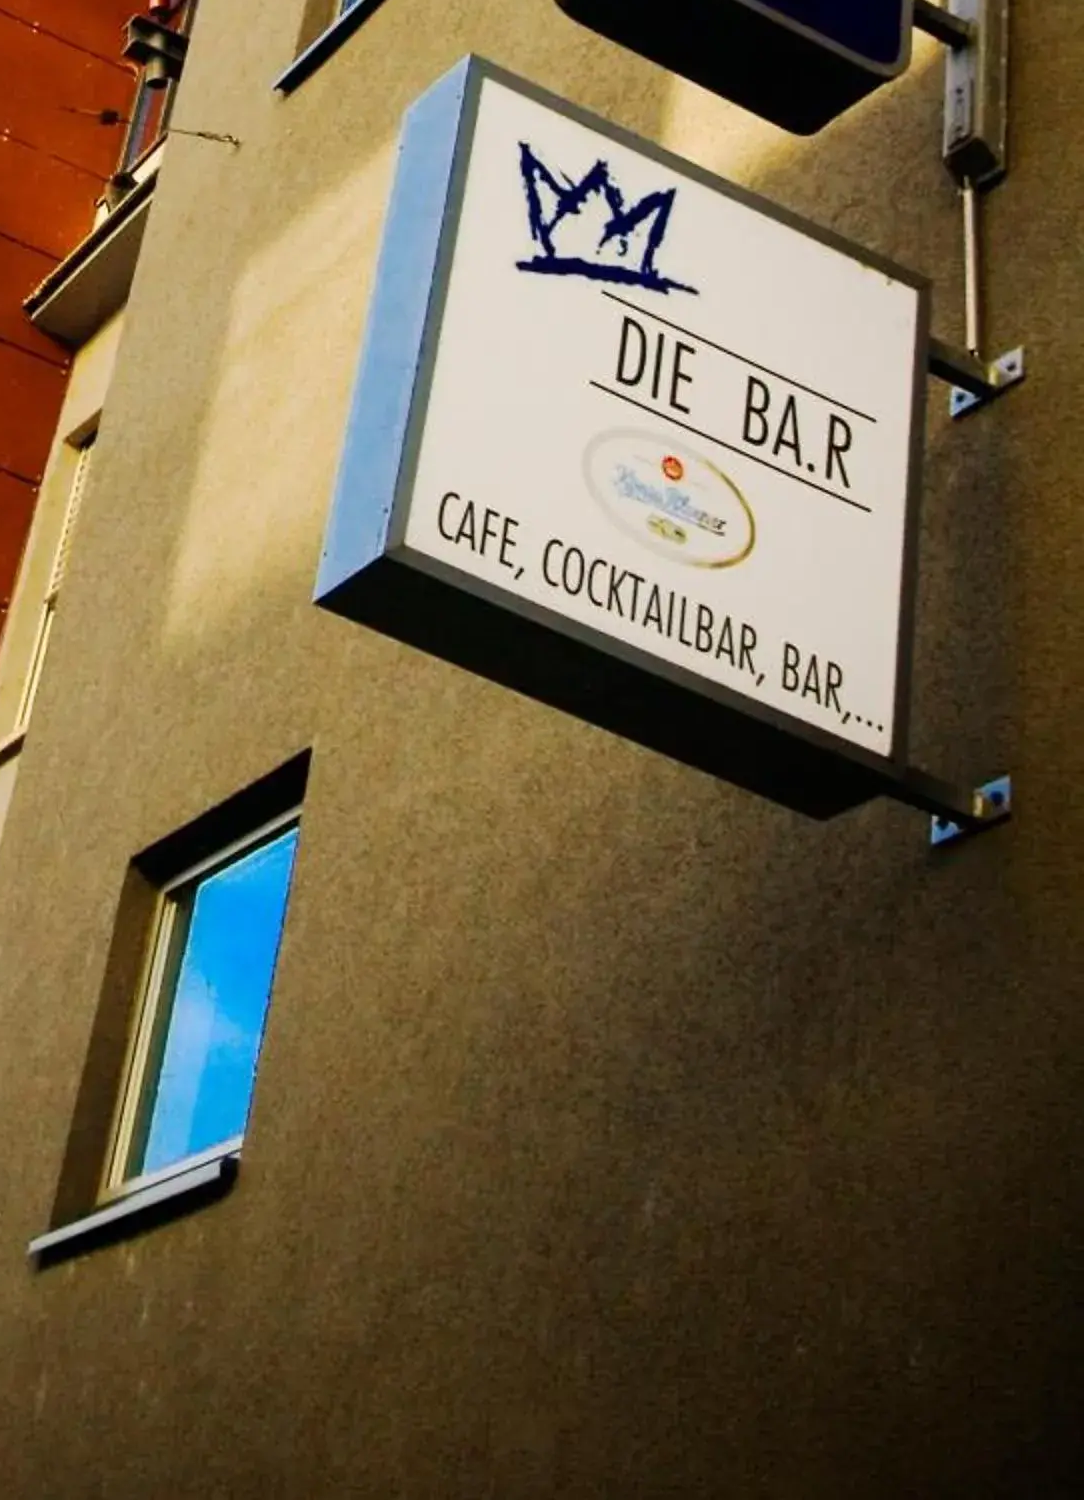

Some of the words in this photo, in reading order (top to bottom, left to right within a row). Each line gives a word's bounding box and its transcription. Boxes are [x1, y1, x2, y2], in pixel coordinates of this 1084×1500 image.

[615, 315, 696, 415] DIE
[742, 375, 853, 489] BA.R
[436, 490, 525, 580] CAFE,
[542, 538, 766, 687] COCKTAILBAR,
